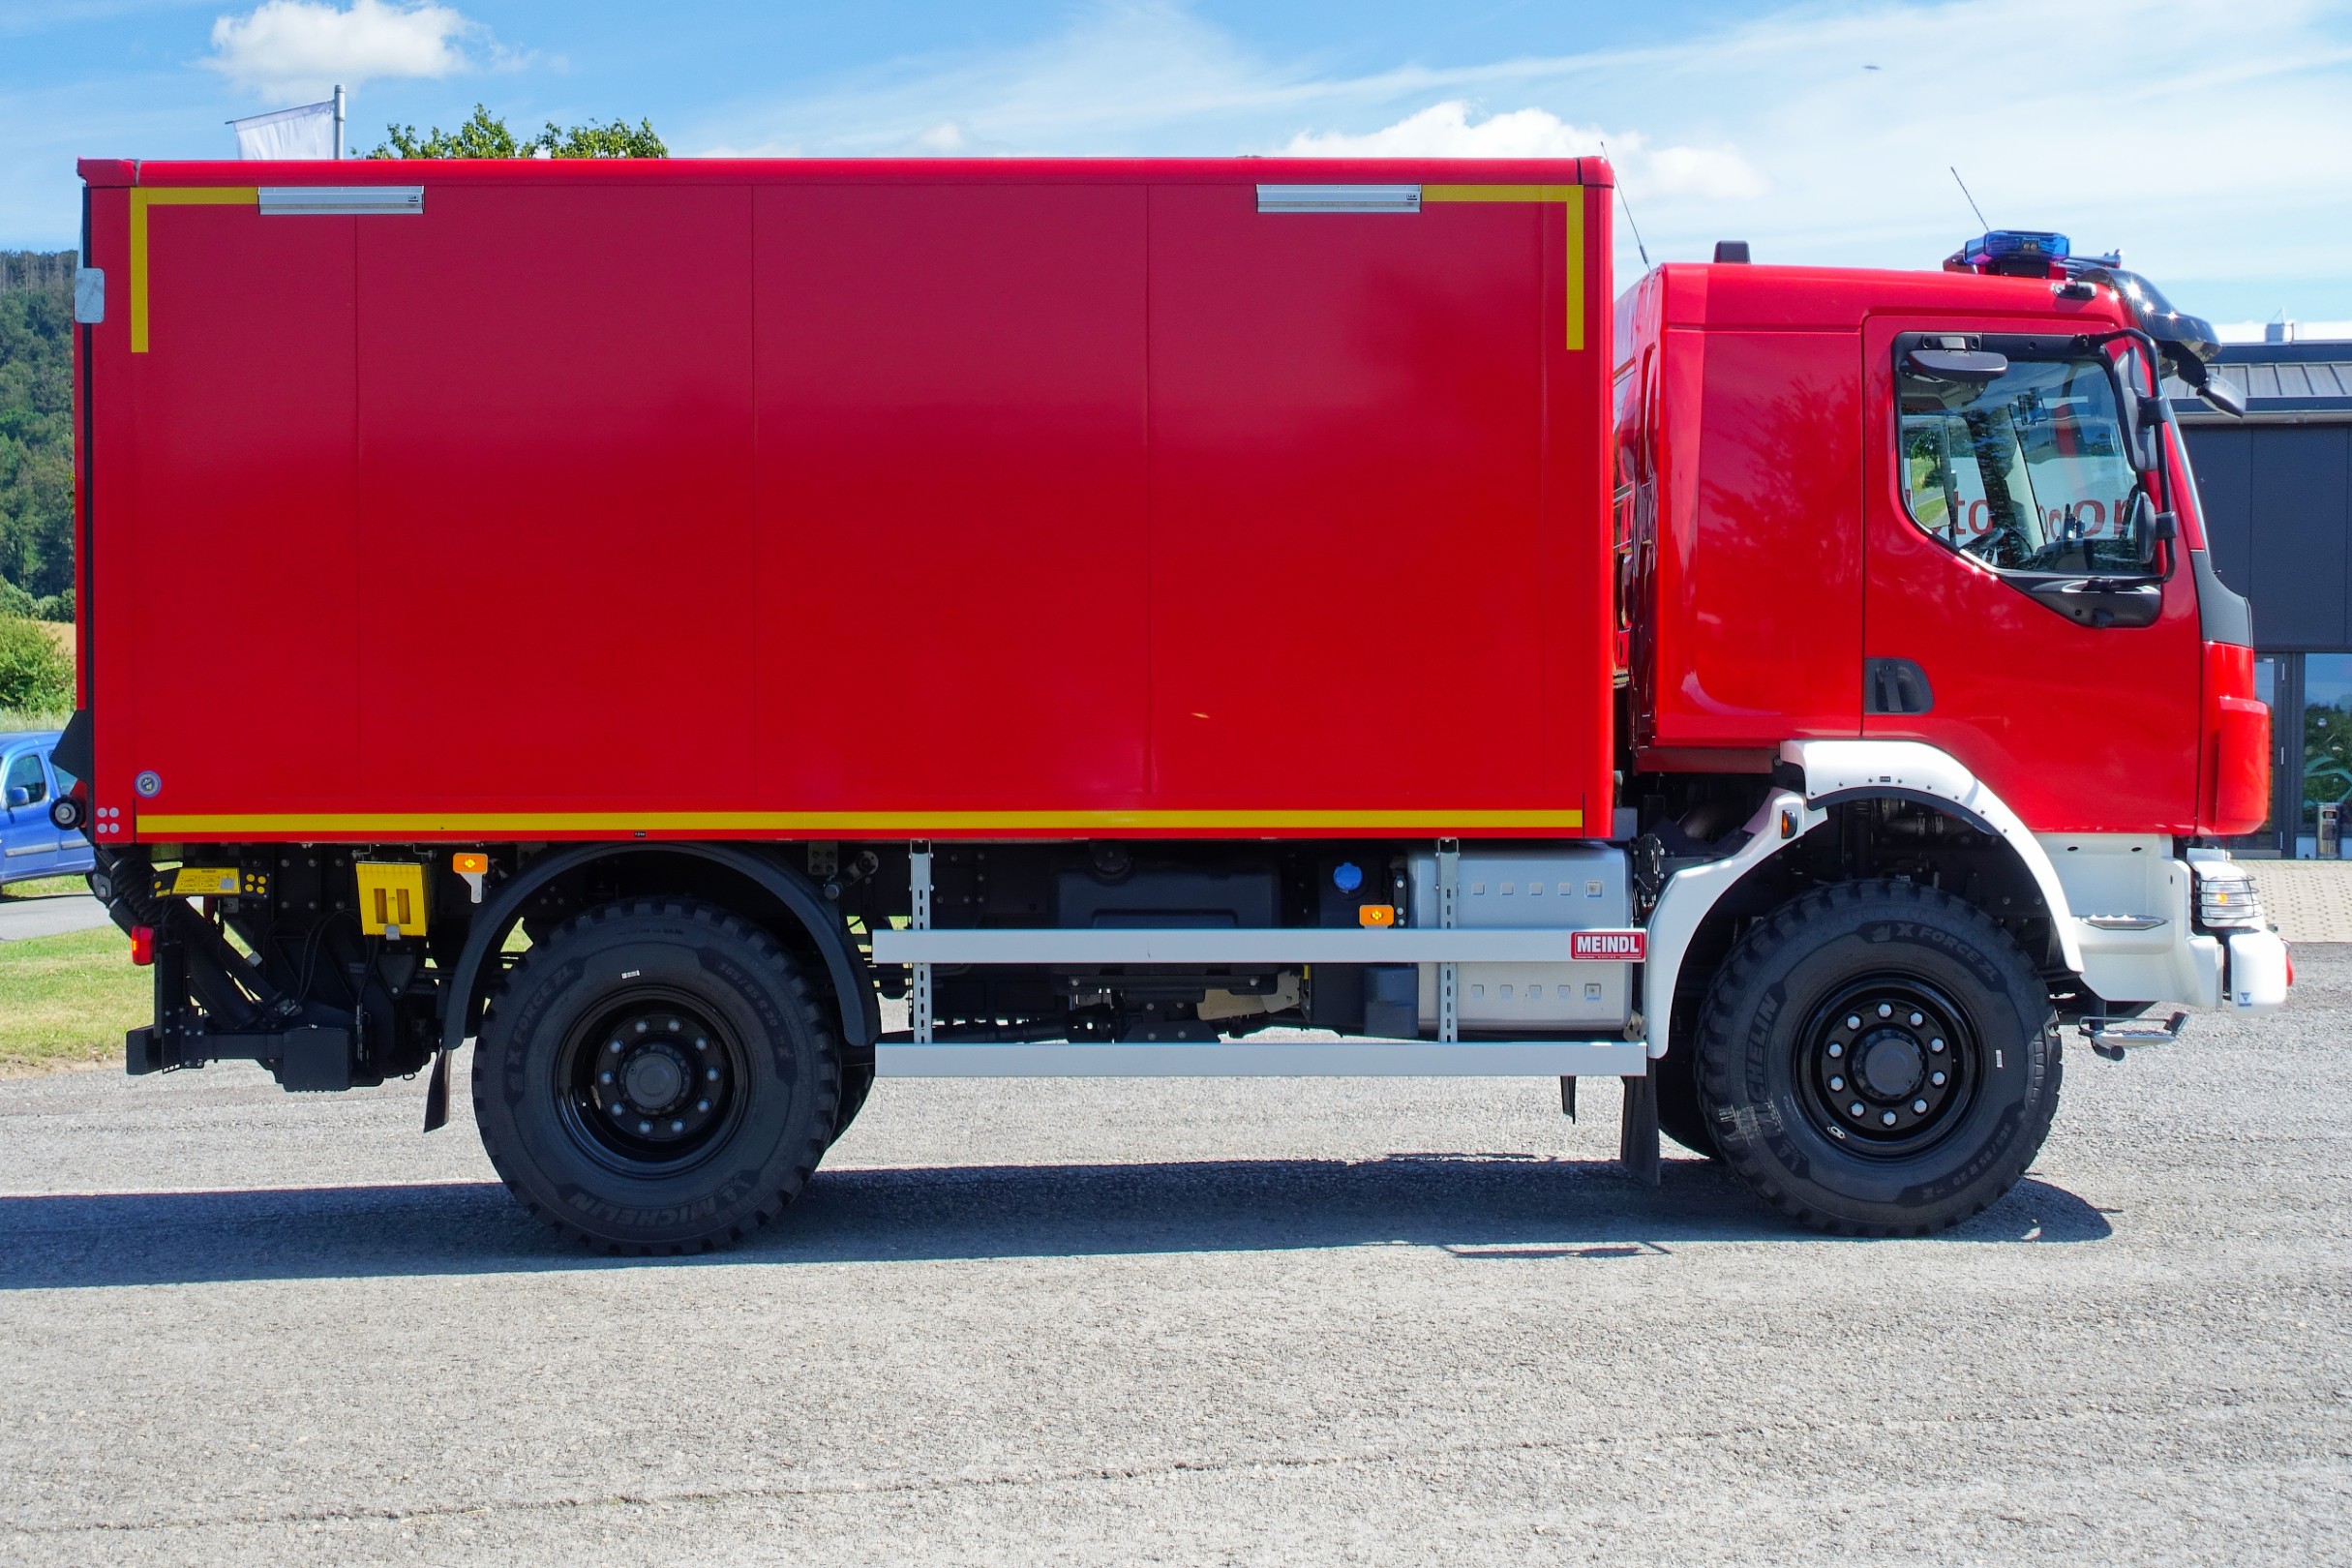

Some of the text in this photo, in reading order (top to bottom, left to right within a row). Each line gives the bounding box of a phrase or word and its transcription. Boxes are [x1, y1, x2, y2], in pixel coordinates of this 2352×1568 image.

[1577, 936, 1640, 953] MEINDL
[1918, 926, 1981, 963] FORCE
[513, 980, 553, 1044] FORCE
[567, 1191, 717, 1227] MICHELIN
